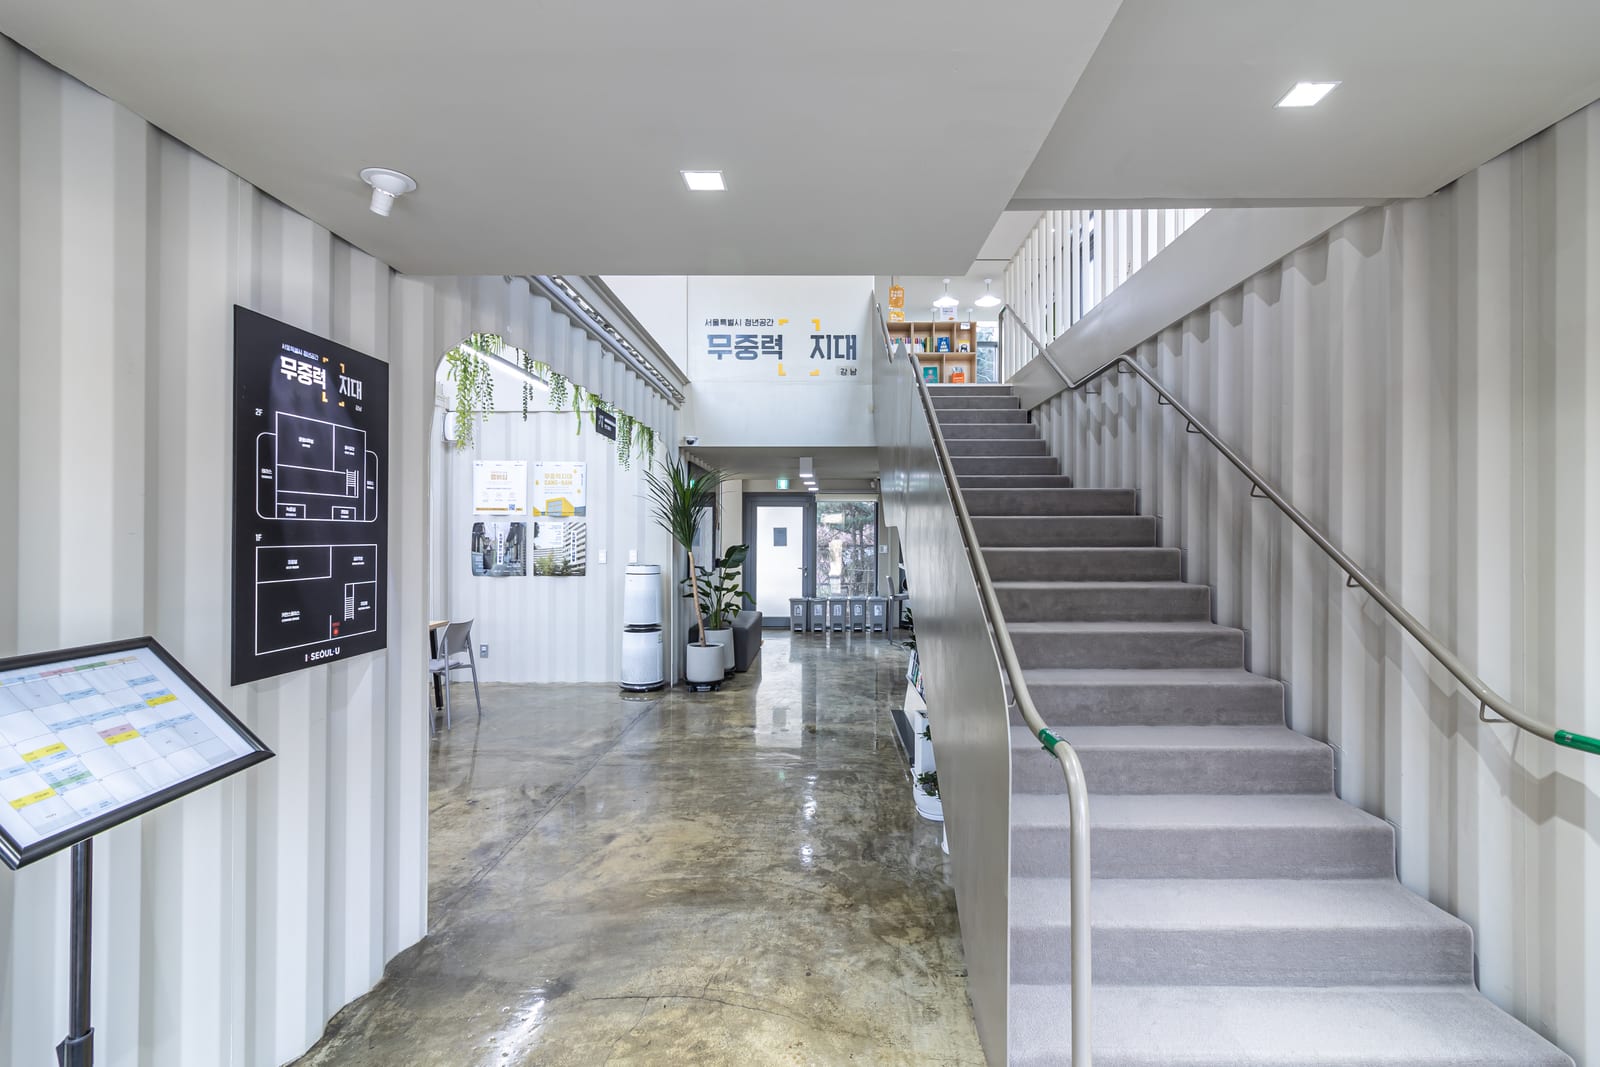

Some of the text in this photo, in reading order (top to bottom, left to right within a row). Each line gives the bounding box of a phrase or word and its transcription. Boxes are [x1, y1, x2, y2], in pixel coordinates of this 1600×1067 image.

[704, 318, 774, 327] 서울특별시 청년공간
[706, 334, 857, 361] 무중력 지대
[280, 355, 363, 401] 무중력 지대
